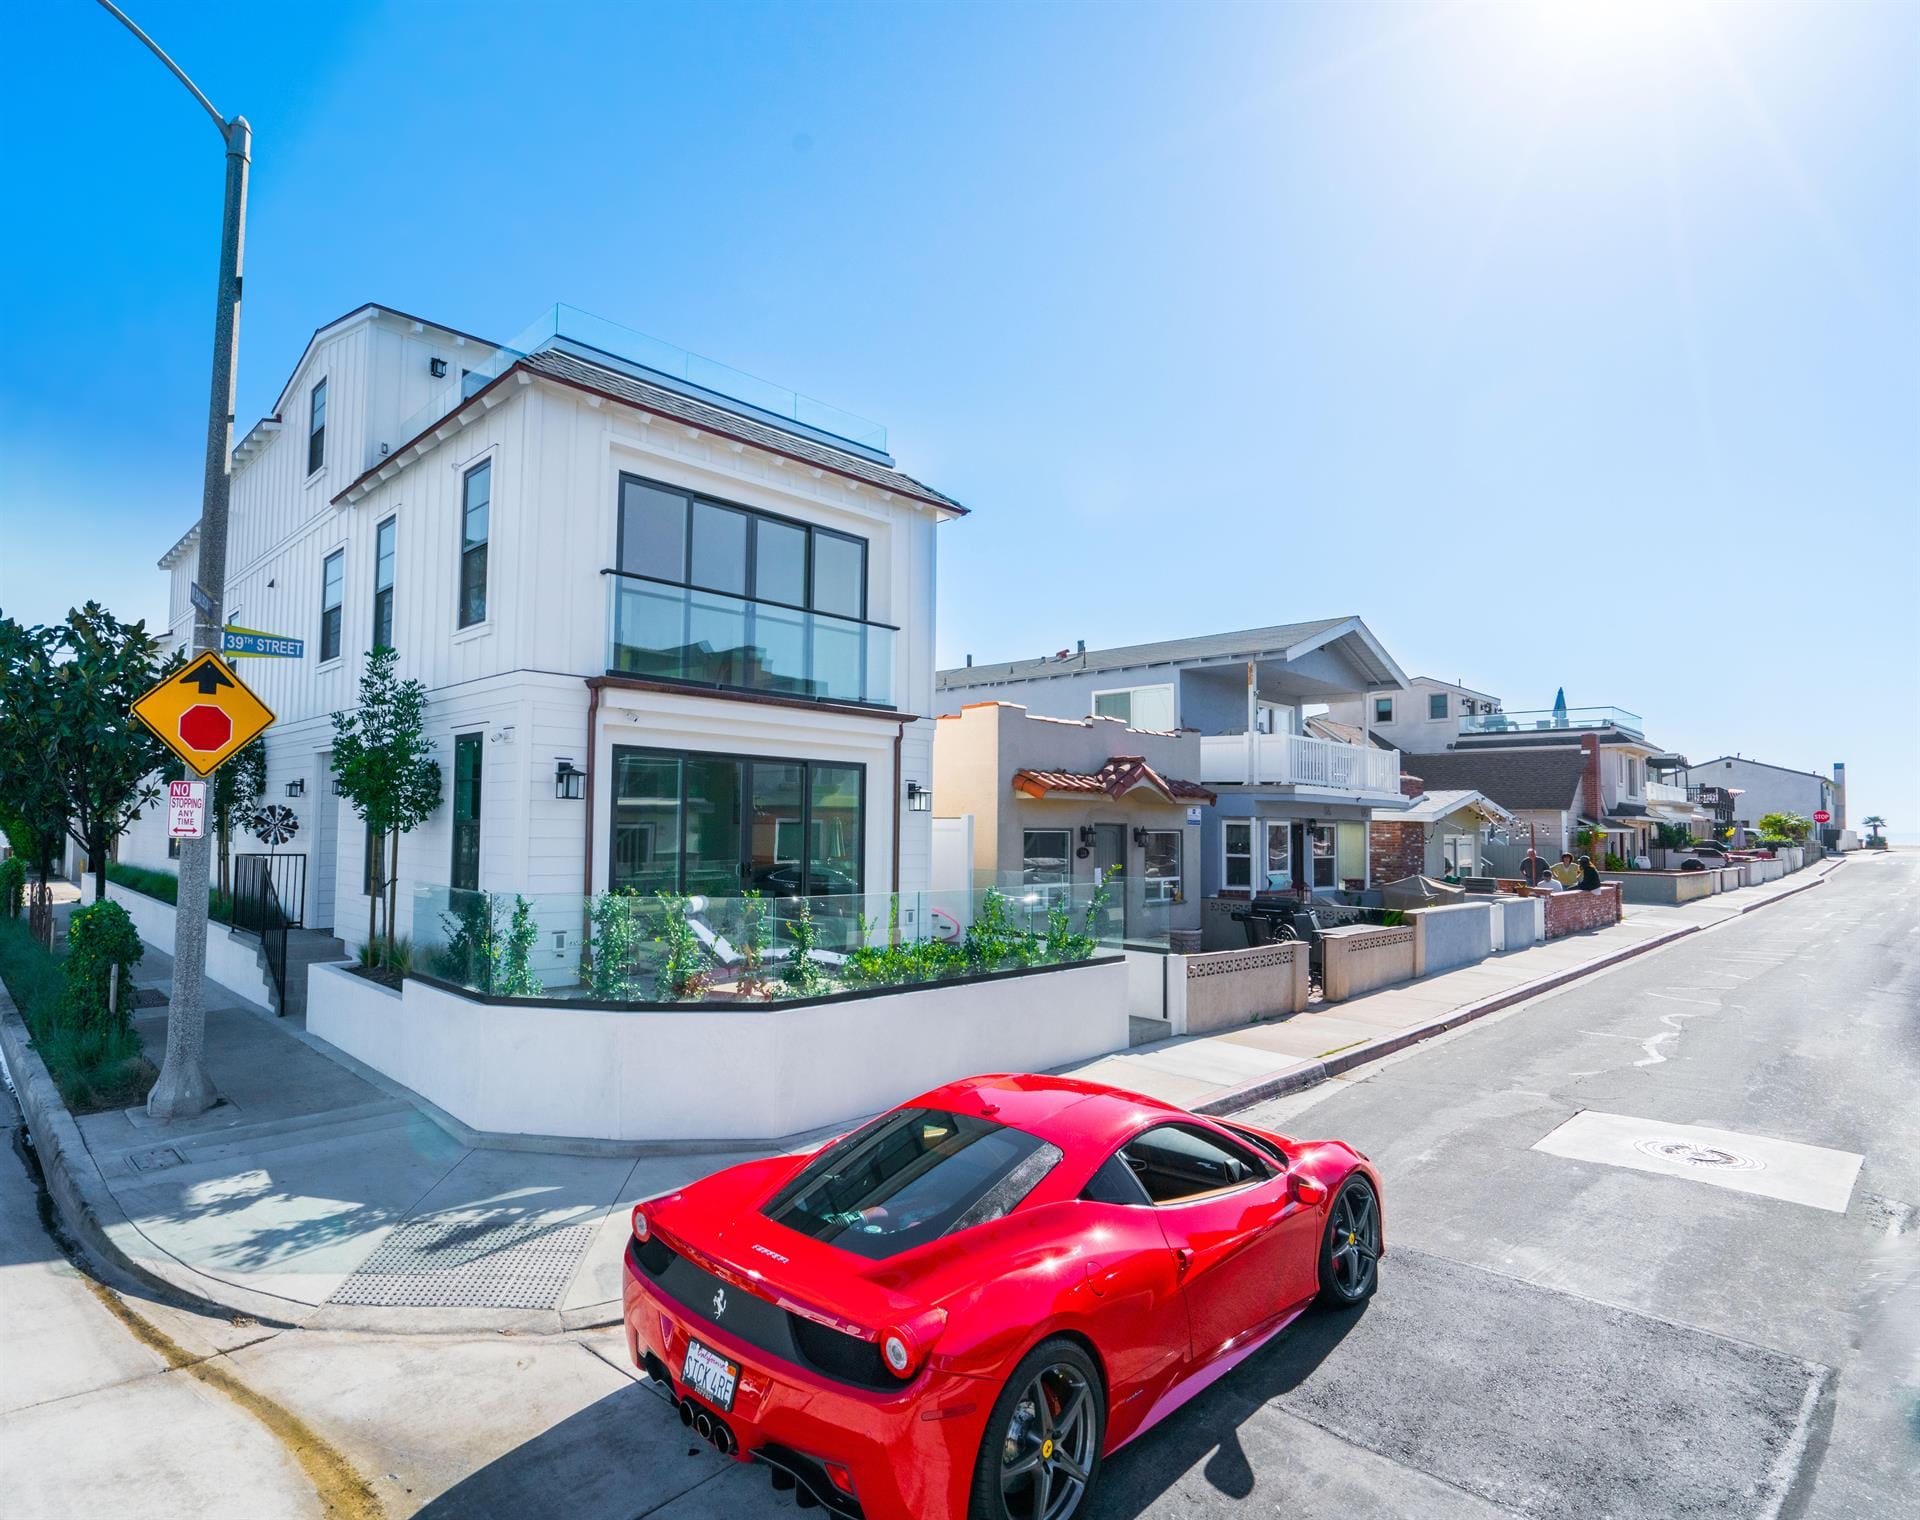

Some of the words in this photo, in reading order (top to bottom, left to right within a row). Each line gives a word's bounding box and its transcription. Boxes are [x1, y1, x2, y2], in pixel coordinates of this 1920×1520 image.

[227, 634, 253, 649] 39TH
[256, 638, 302, 655] STREET
[172, 784, 189, 796] NO
[171, 797, 202, 809] STOPPING
[177, 817, 195, 825] TIME
[684, 1355, 711, 1388] SICK
